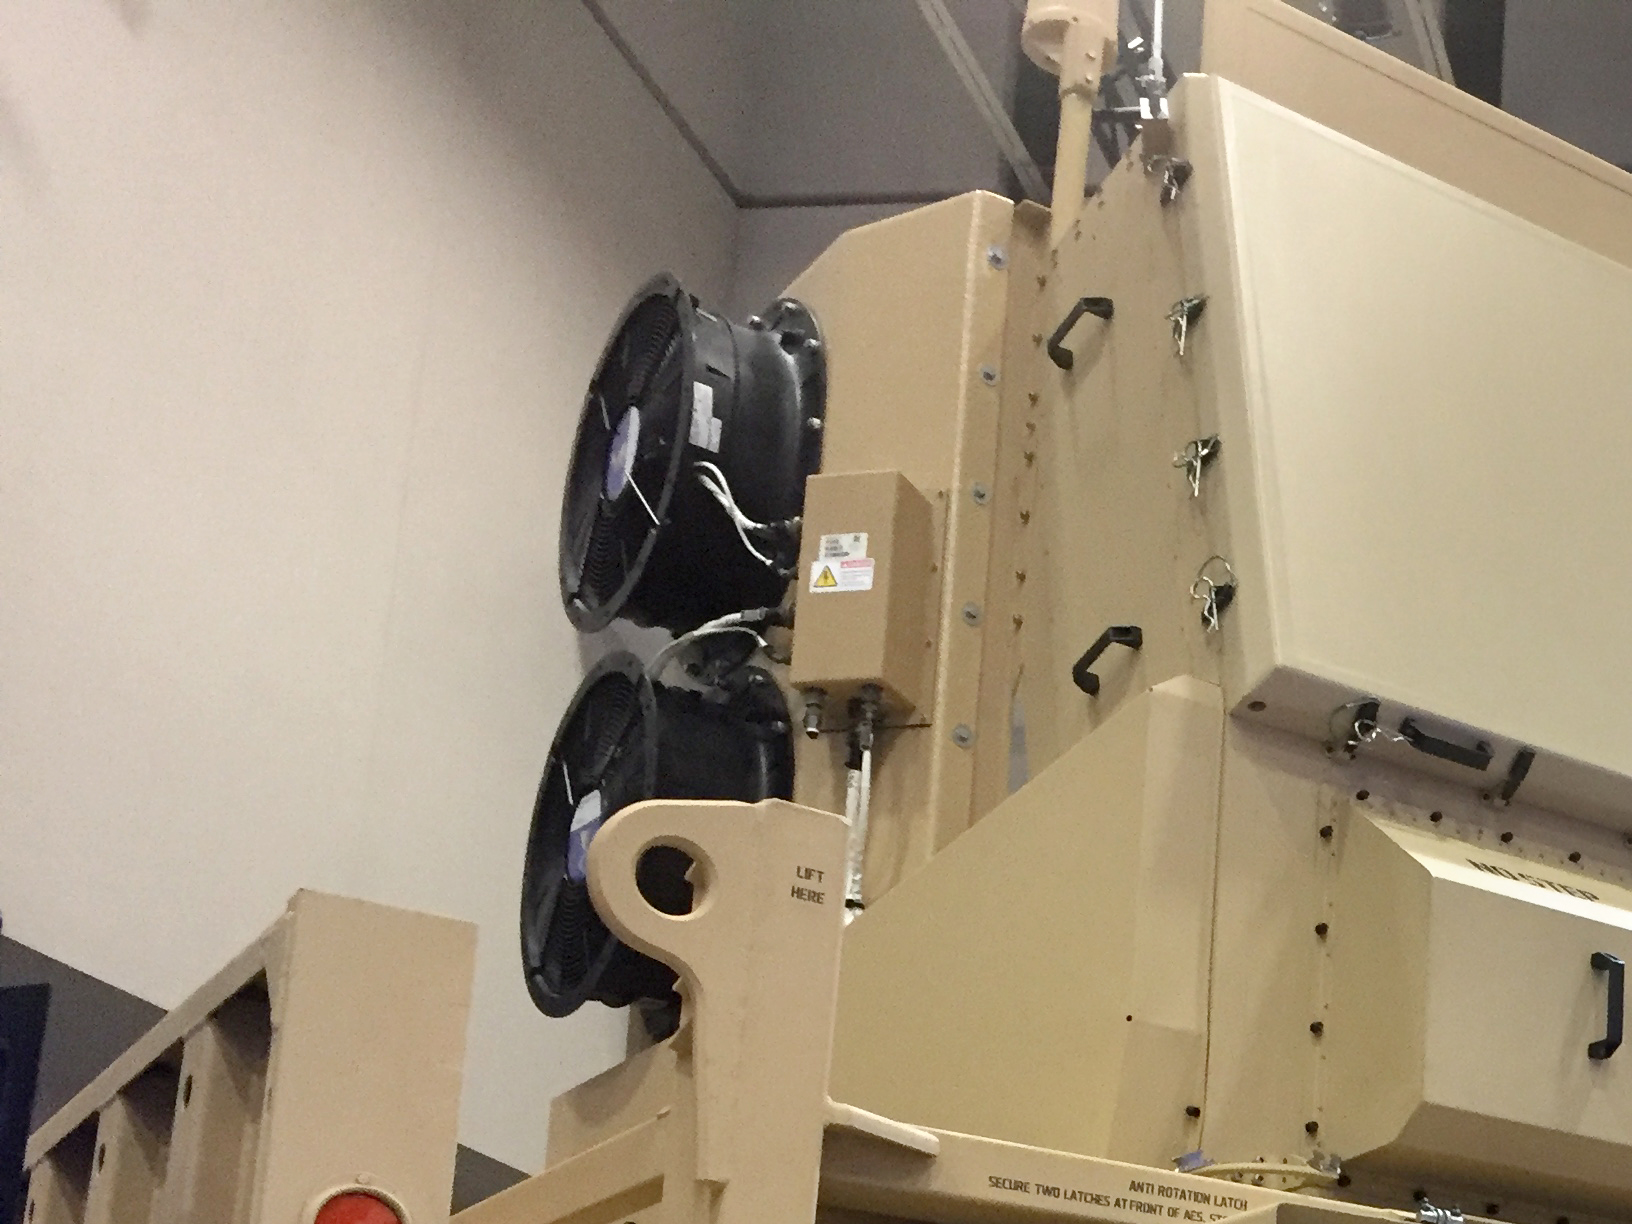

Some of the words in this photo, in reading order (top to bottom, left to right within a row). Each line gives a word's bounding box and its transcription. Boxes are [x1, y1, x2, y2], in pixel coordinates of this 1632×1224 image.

[796, 865, 825, 883] LIFT
[790, 885, 826, 904] HERE
[988, 1175, 1031, 1194] SECURE
[1034, 1183, 1060, 1198] TWO
[1063, 1189, 1111, 1207] LATCHES
[1113, 1197, 1128, 1210] AT
[1129, 1199, 1164, 1216] FRONT
[1166, 1206, 1180, 1218] OF
[1128, 1180, 1154, 1195] ANTI
[1158, 1185, 1211, 1206] ROTATION
[1213, 1195, 1248, 1211] LATCH
